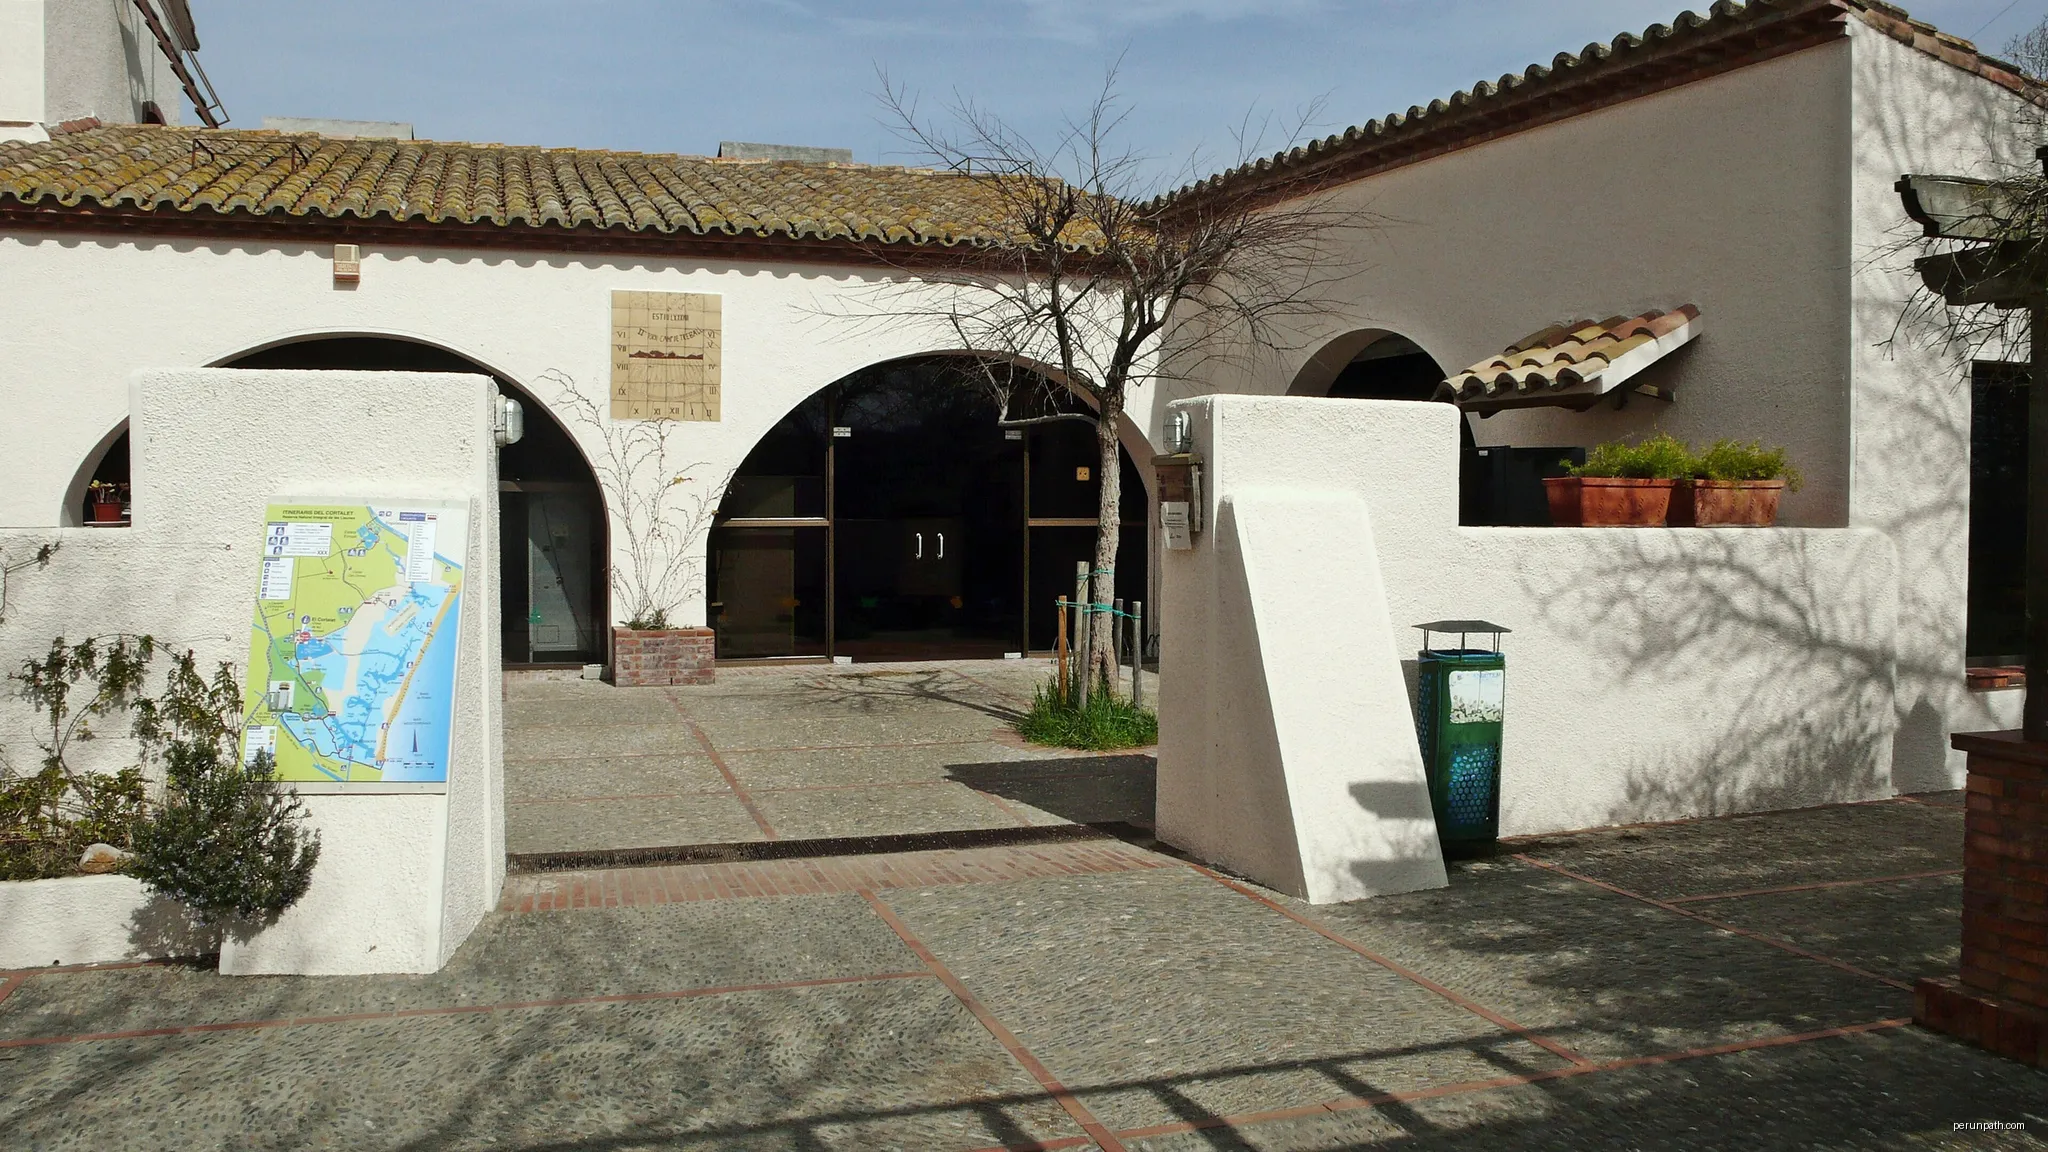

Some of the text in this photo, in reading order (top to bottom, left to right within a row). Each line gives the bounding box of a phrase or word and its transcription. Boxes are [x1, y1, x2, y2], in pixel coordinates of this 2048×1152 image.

[616, 363, 629, 371] VIII
[618, 388, 626, 396] IX
[709, 386, 717, 395] III
[669, 407, 679, 415] XII
